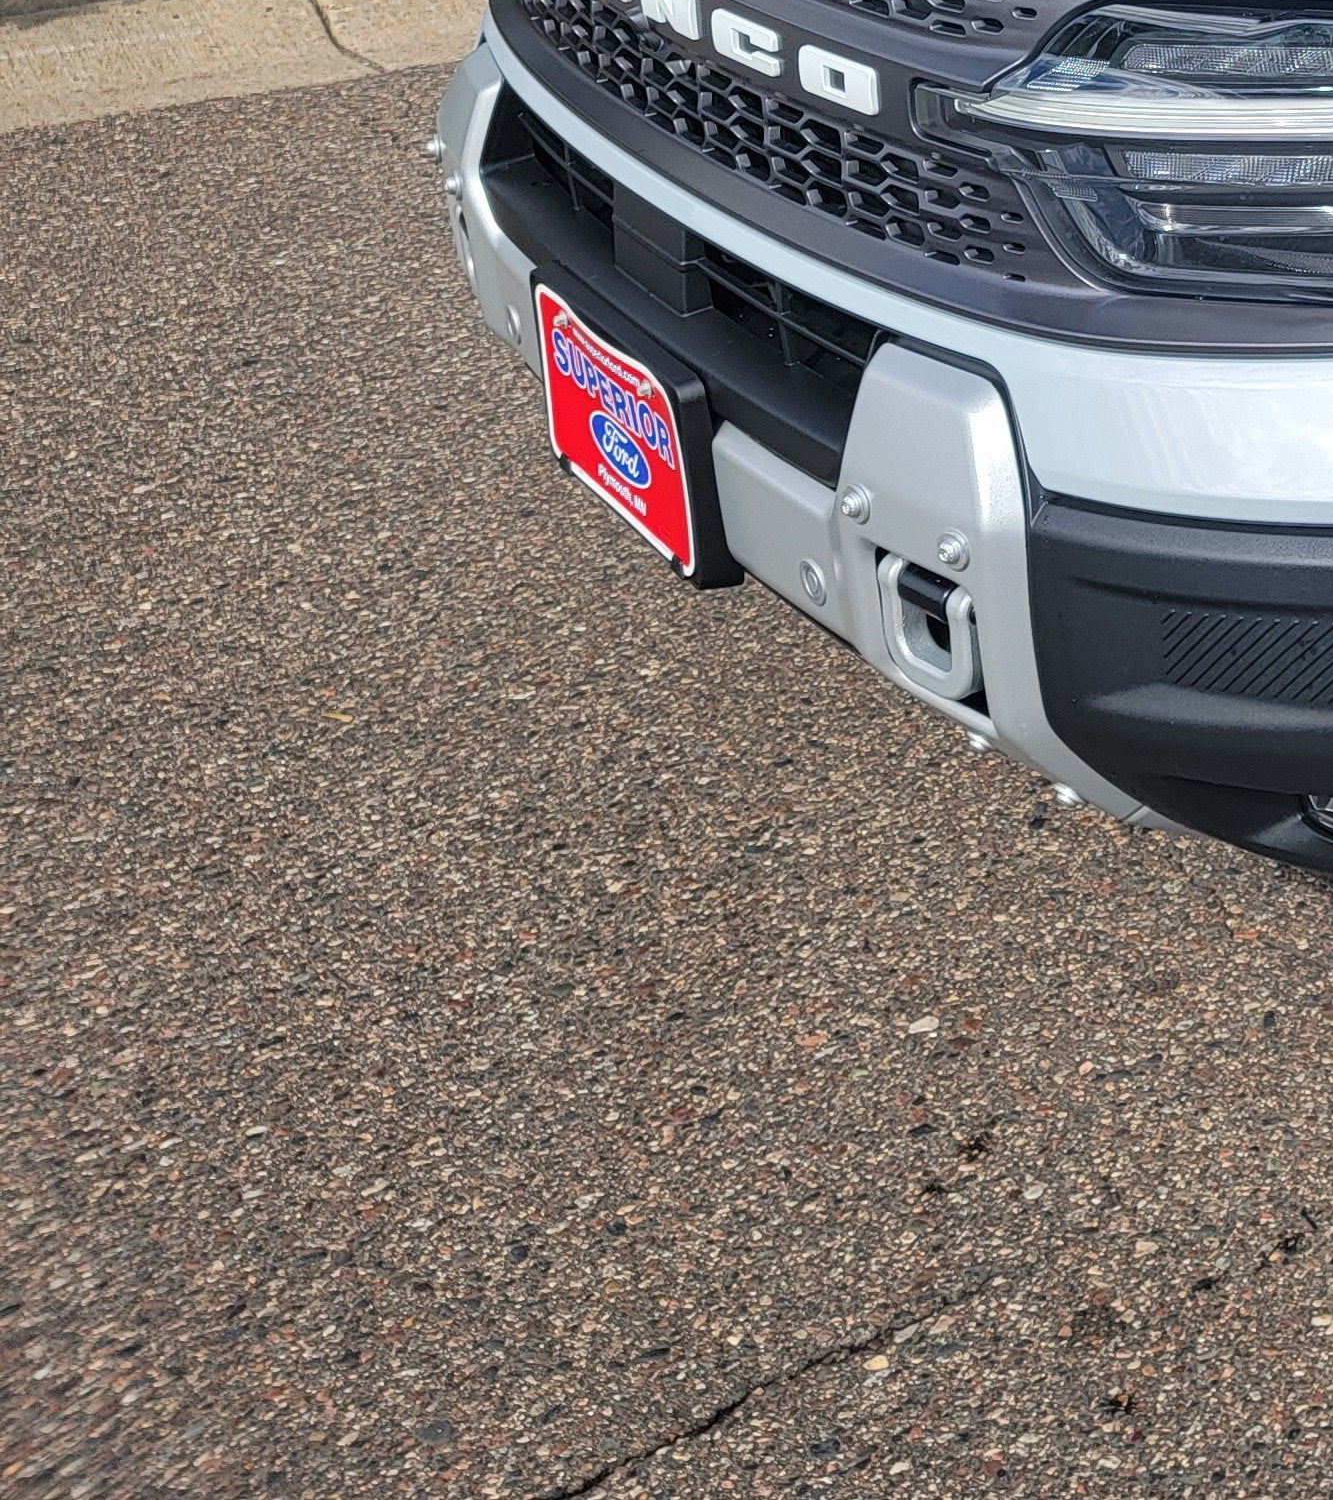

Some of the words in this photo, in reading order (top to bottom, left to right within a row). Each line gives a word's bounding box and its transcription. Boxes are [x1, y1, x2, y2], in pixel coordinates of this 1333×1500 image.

[552, 328, 675, 470] SUPERIOR
[602, 421, 640, 479] Ford
[633, 496, 648, 518] MN
